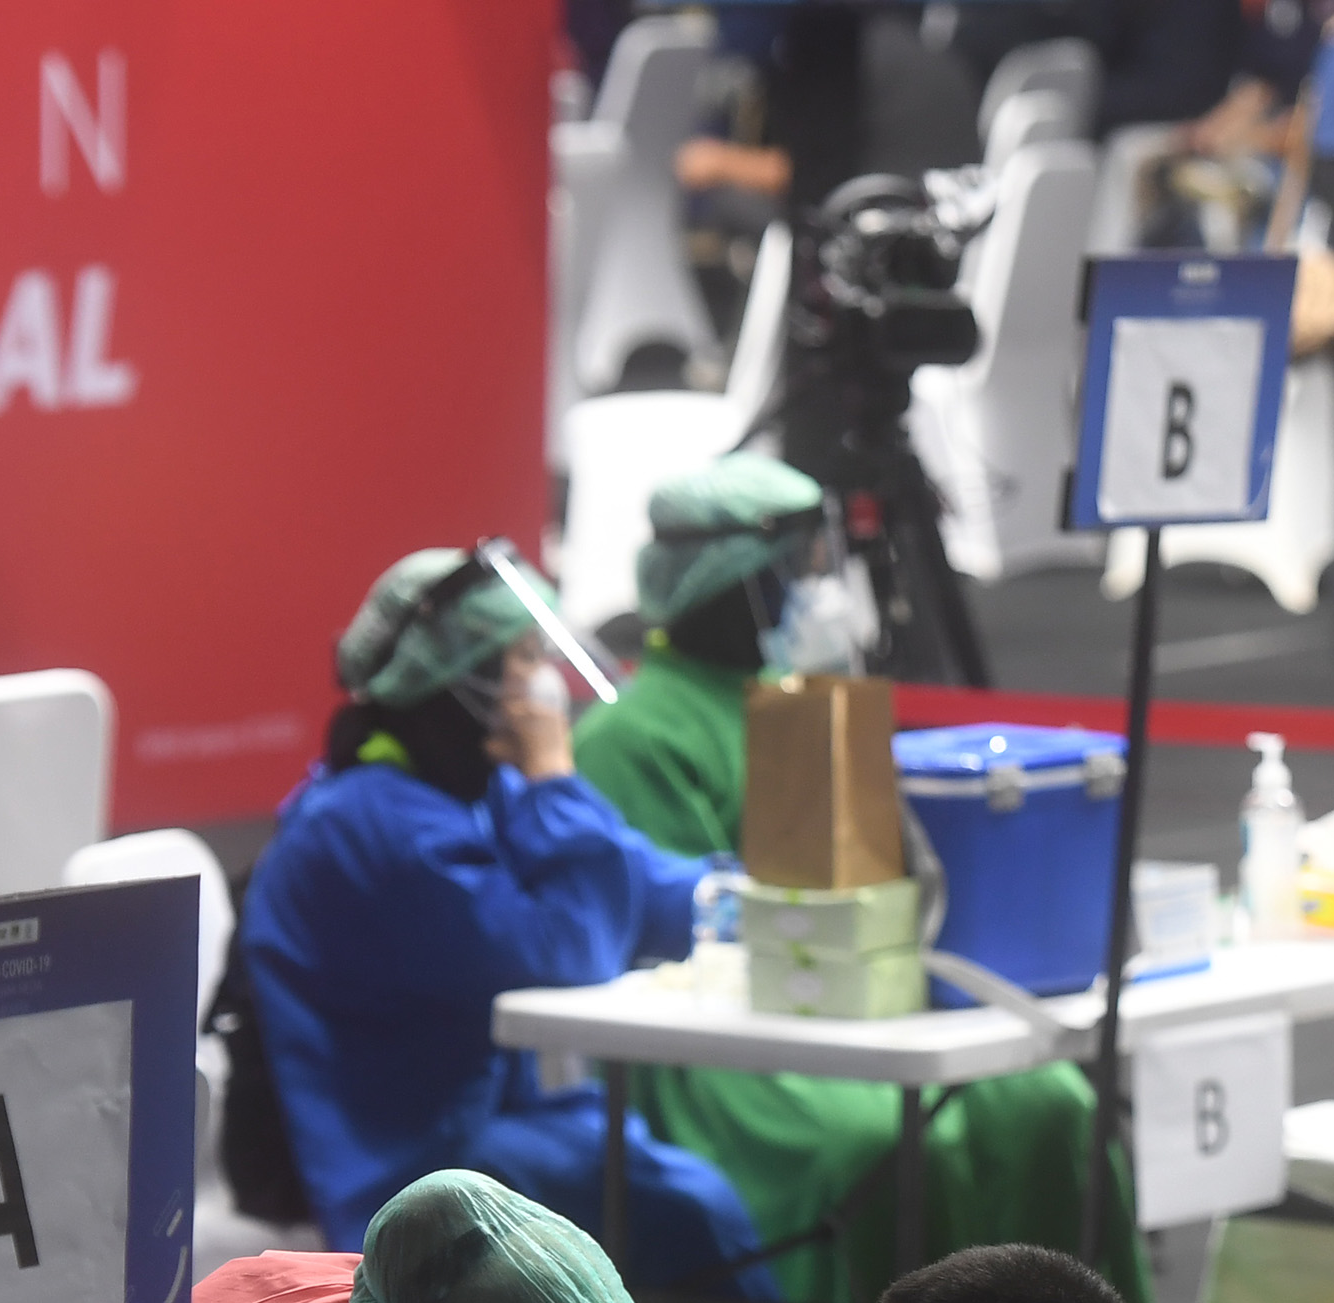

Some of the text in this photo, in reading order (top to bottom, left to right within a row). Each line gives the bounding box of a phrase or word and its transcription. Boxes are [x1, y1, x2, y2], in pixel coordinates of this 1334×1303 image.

[1161, 381, 1195, 481] B
[2, 954, 50, 979] COVID-19
[1193, 1079, 1230, 1157] B
